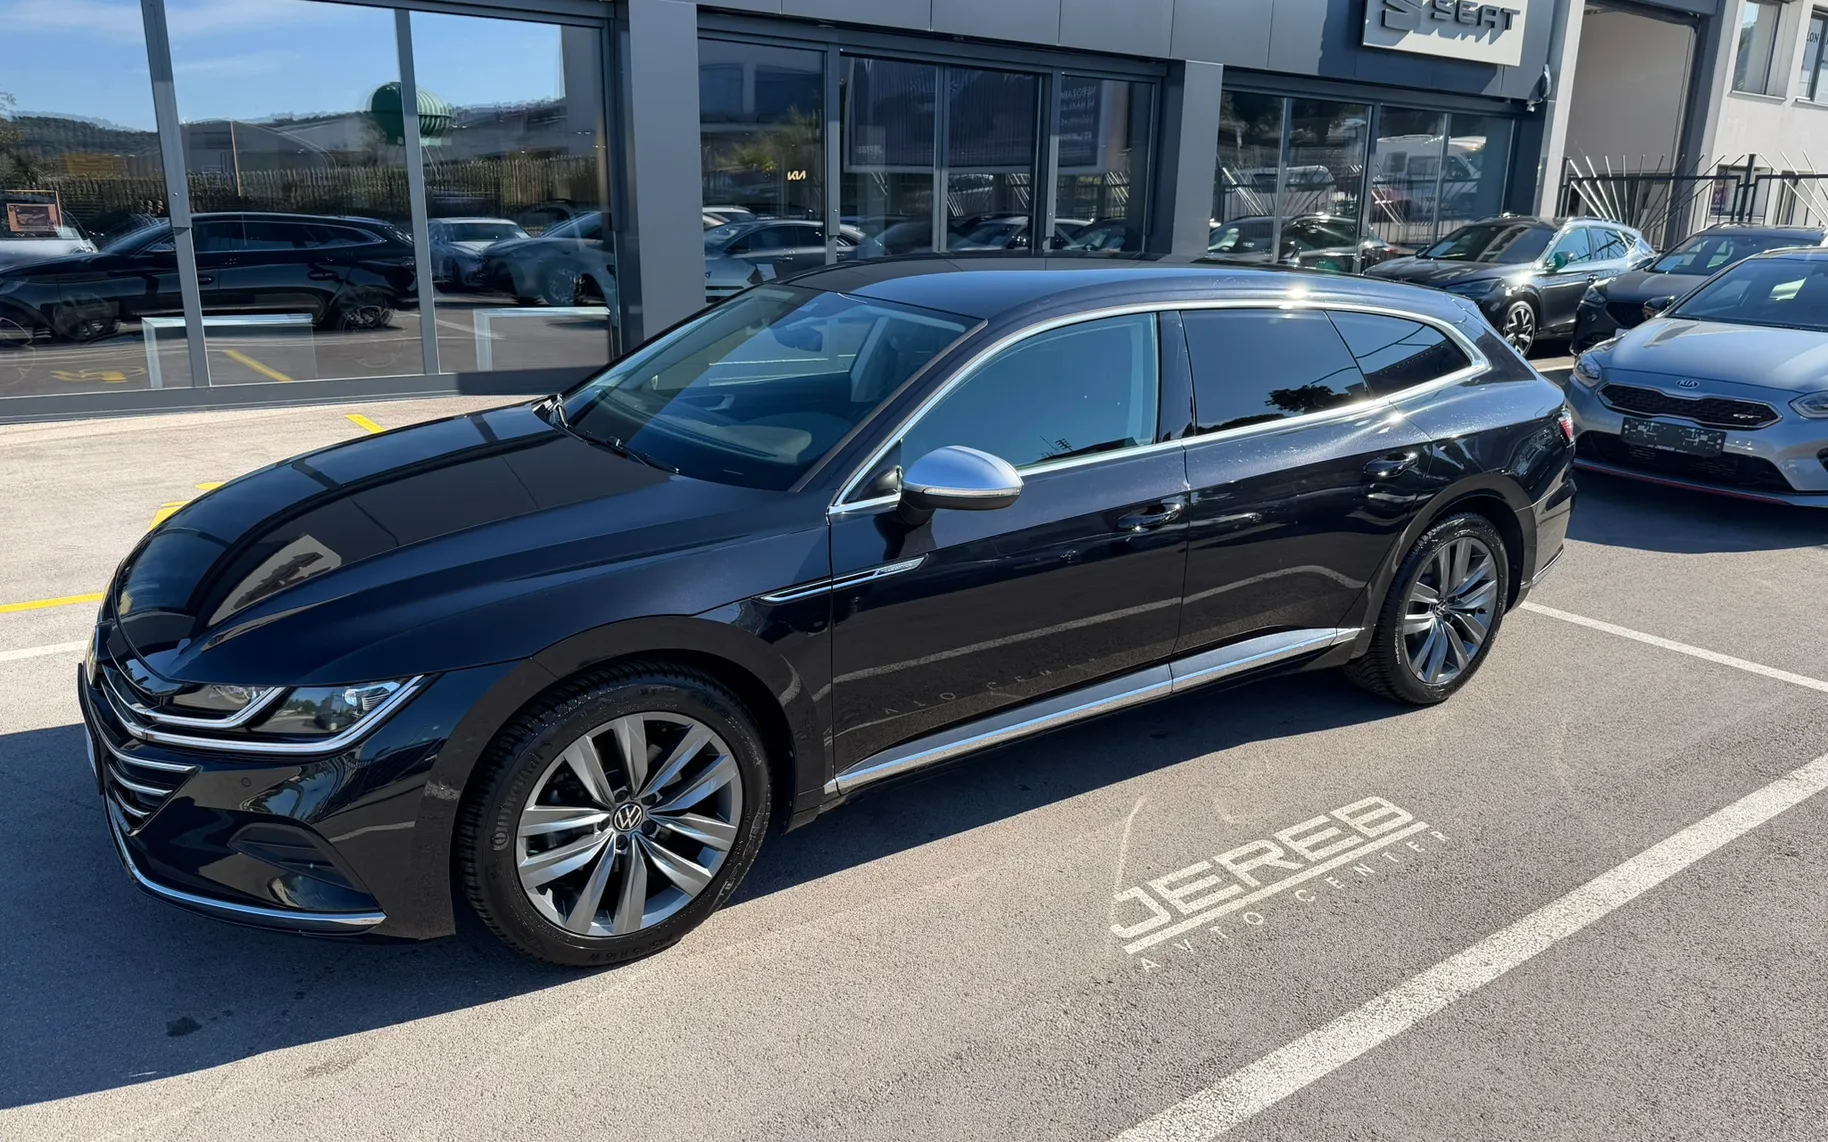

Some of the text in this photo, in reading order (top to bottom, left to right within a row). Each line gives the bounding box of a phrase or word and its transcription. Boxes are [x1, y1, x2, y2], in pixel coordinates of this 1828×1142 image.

[1431, 0, 1521, 31] SEAT
[1110, 795, 1415, 939] JEREB
[1140, 830, 1451, 973] AVTO CENTER
